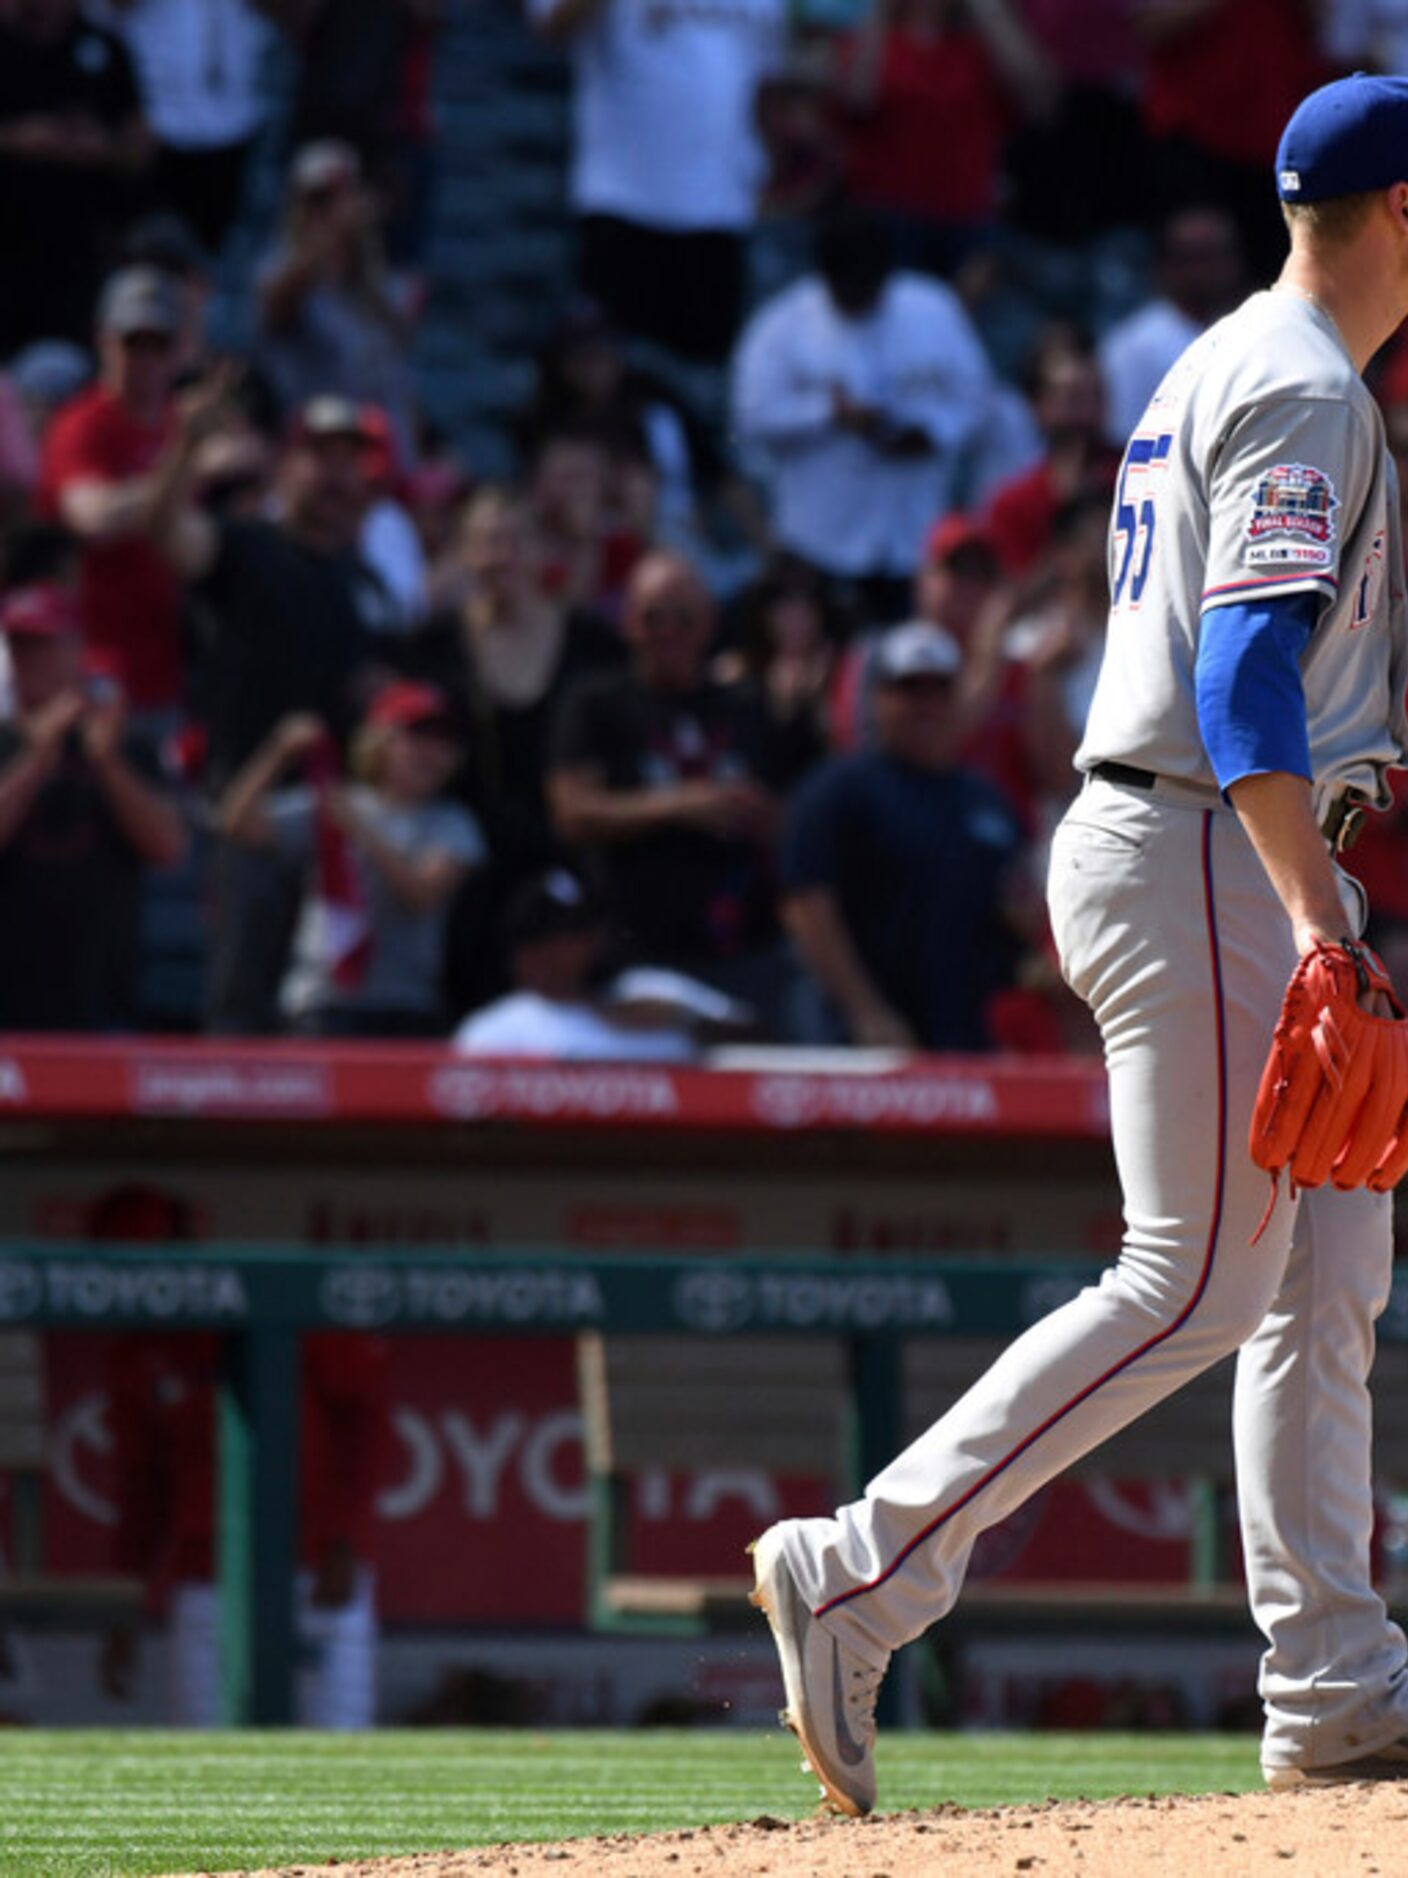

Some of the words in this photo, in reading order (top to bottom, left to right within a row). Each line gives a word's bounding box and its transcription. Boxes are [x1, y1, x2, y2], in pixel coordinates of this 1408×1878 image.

[1110, 432, 1174, 609] 55
[1255, 514, 1282, 531] FINAL
[503, 1070, 679, 1117] TOYOTA
[820, 1075, 996, 1121] TOYOTA
[43, 1264, 250, 1319] TOYOTA
[402, 1270, 605, 1322] TOYOTA
[755, 1273, 956, 1325] TOYOTA
